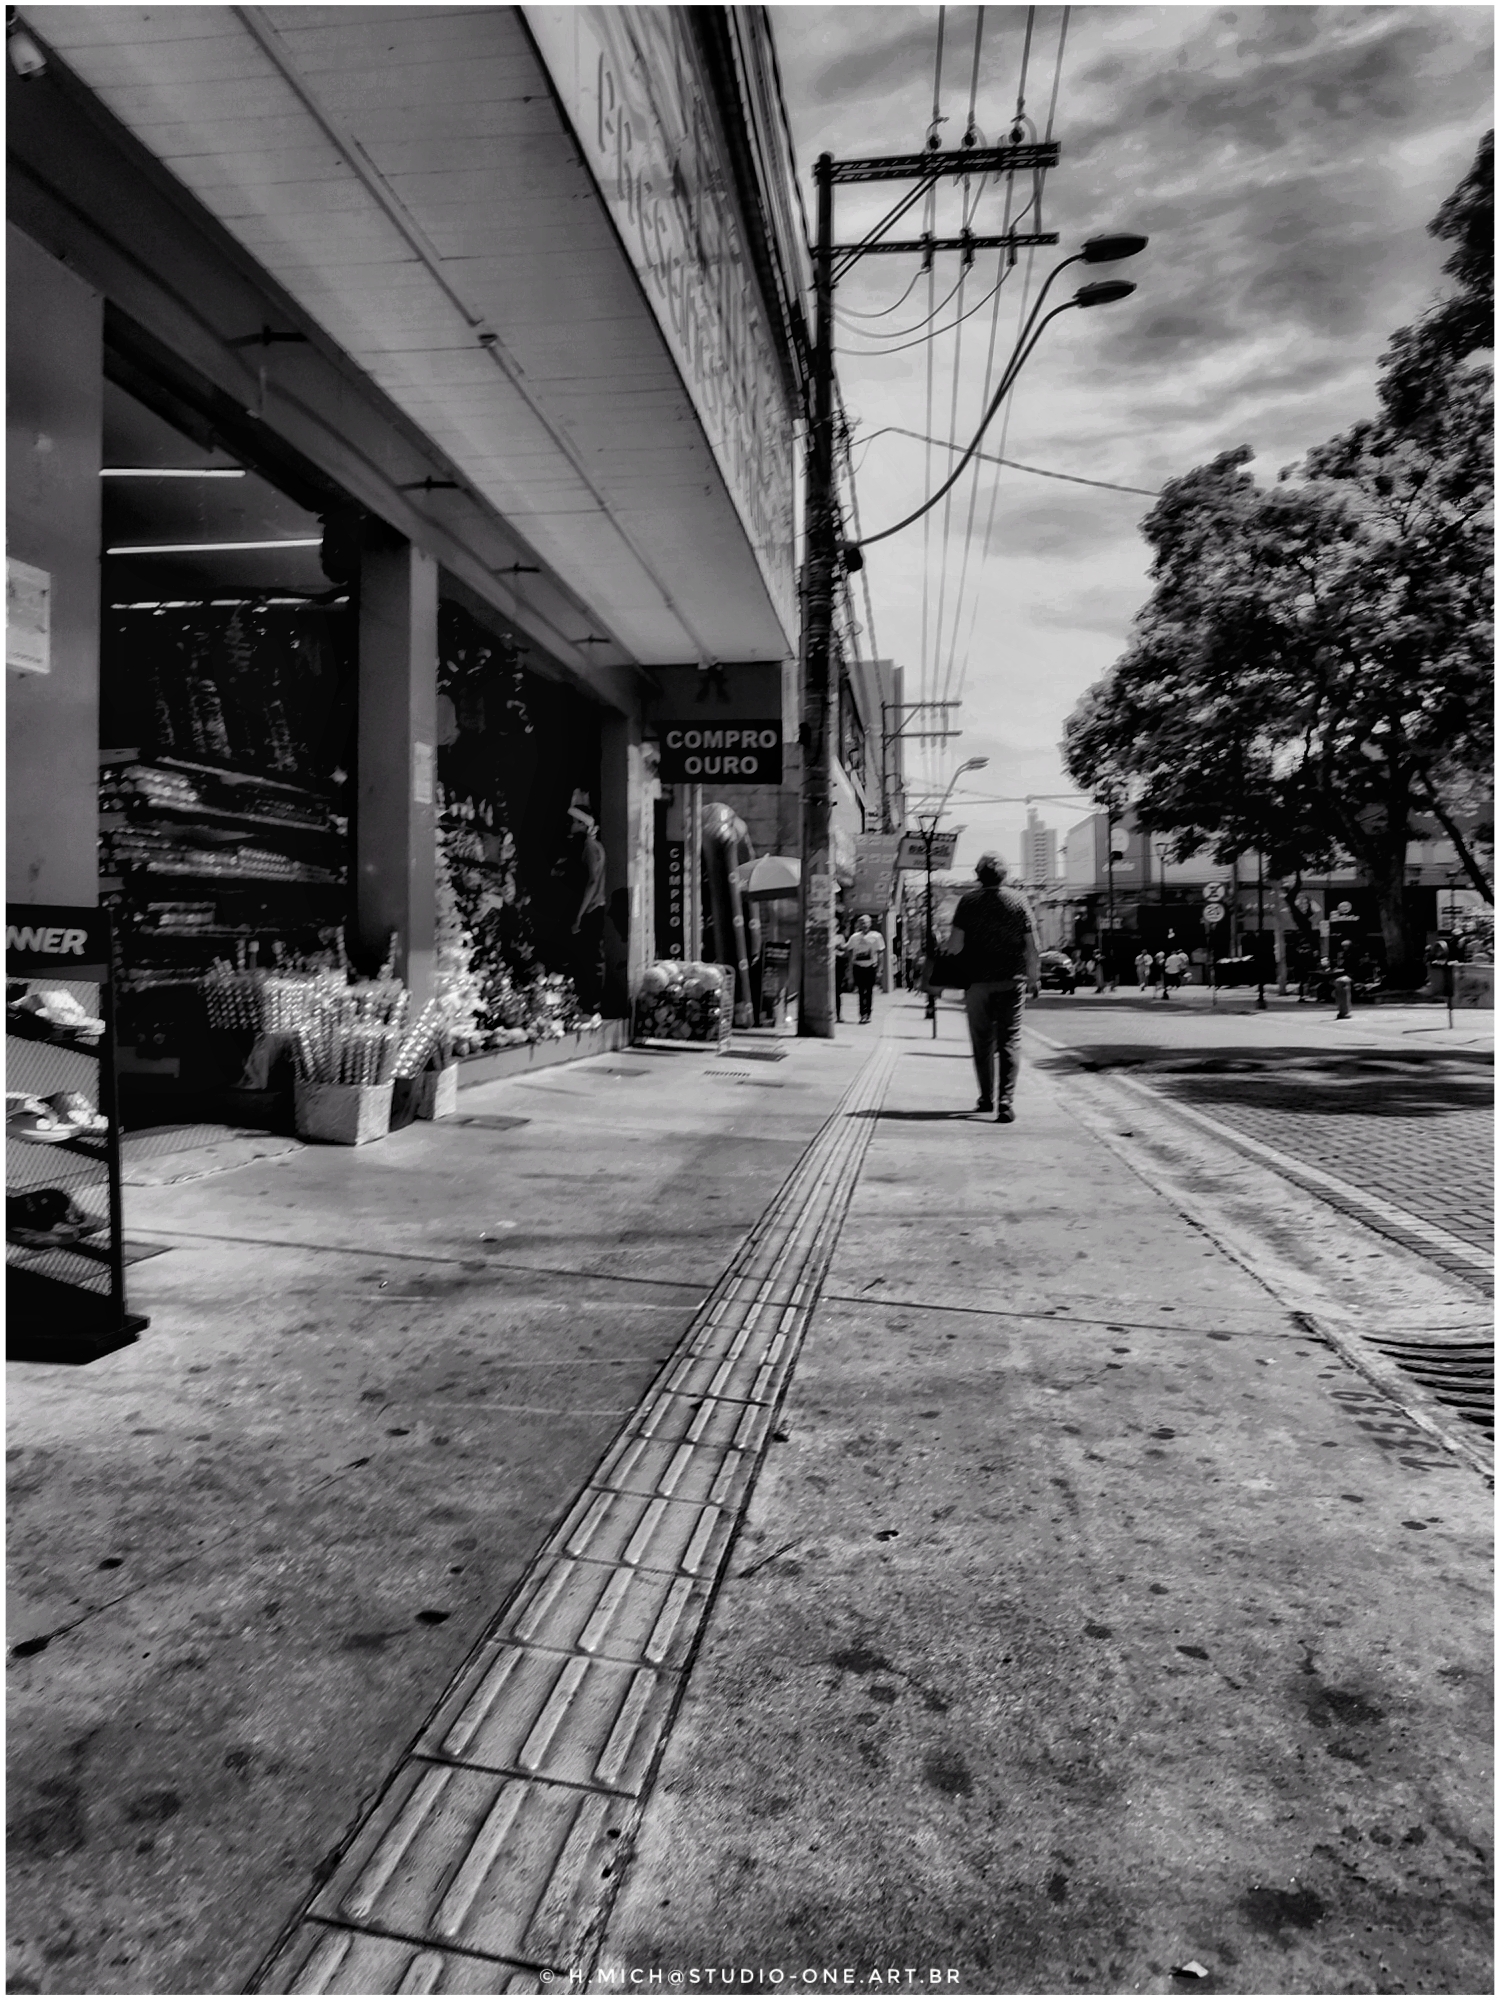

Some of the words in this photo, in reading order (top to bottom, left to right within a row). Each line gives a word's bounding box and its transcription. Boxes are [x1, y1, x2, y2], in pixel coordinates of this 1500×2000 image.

[666, 729, 778, 749] COMPRO
[684, 755, 759, 775] OURO
[668, 847, 681, 928] COMPRO
[669, 943, 682, 961] O
